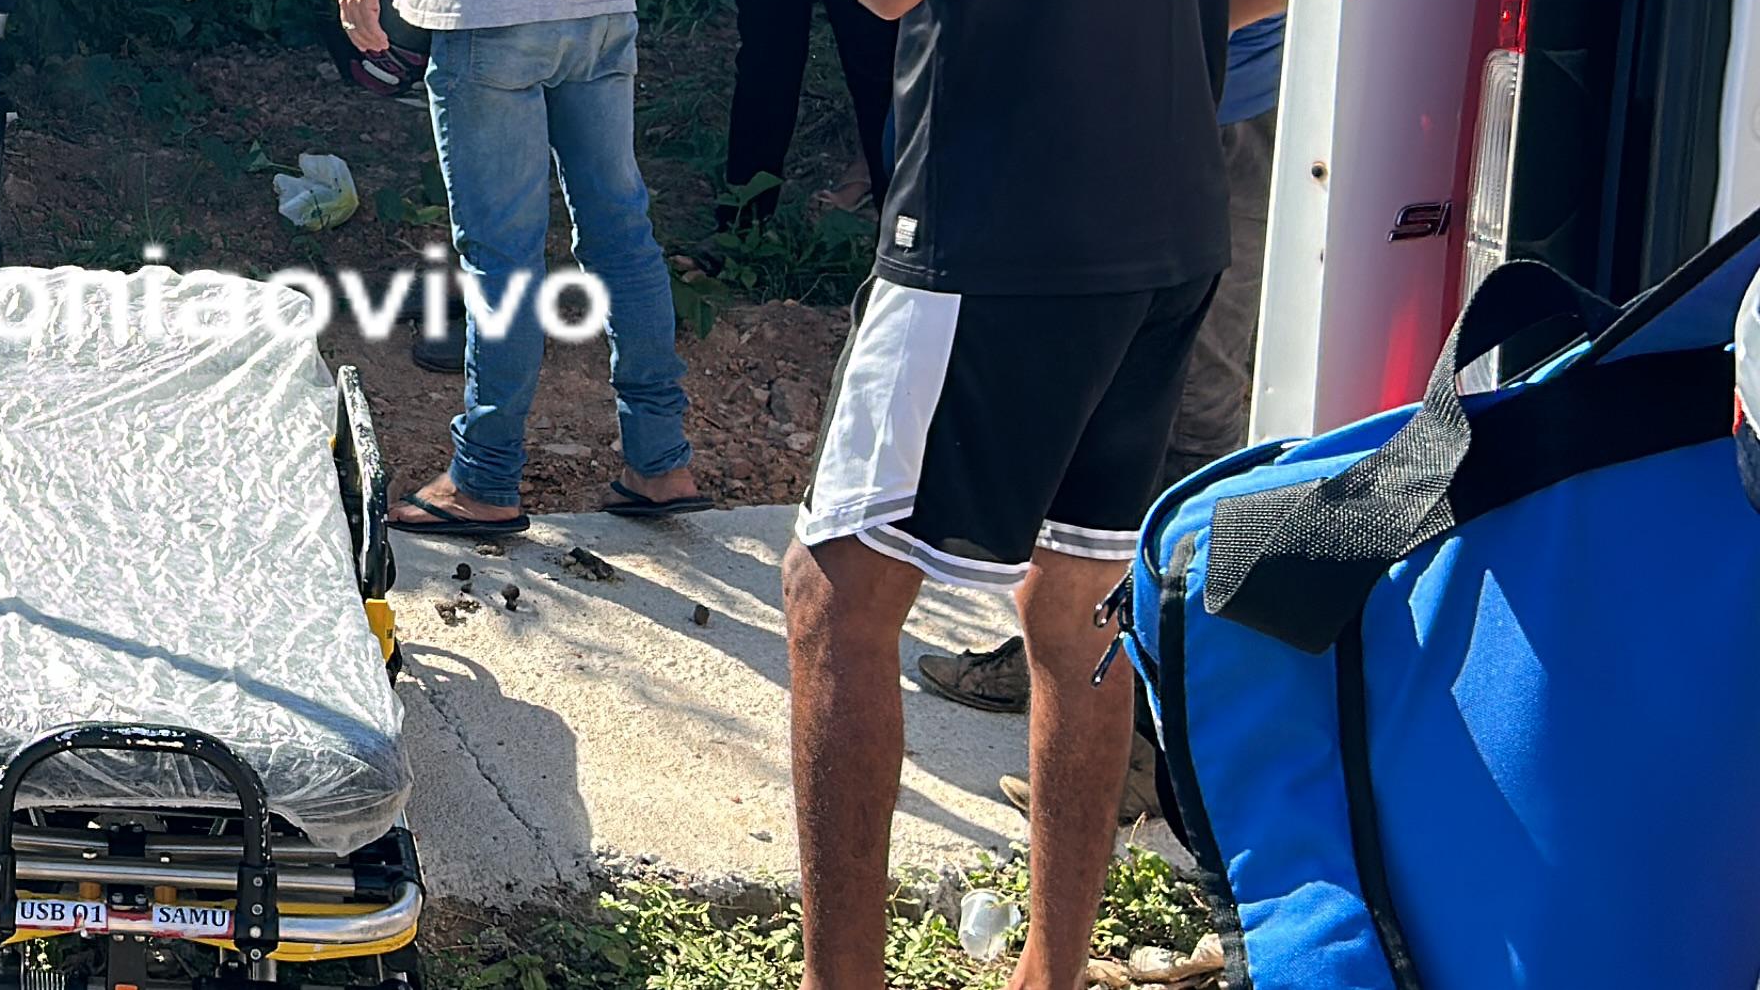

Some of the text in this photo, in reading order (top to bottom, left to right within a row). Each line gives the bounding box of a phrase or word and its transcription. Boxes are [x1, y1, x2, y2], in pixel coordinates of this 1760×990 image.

[19, 901, 103, 923] USB 01
[158, 906, 228, 927] SAMU
